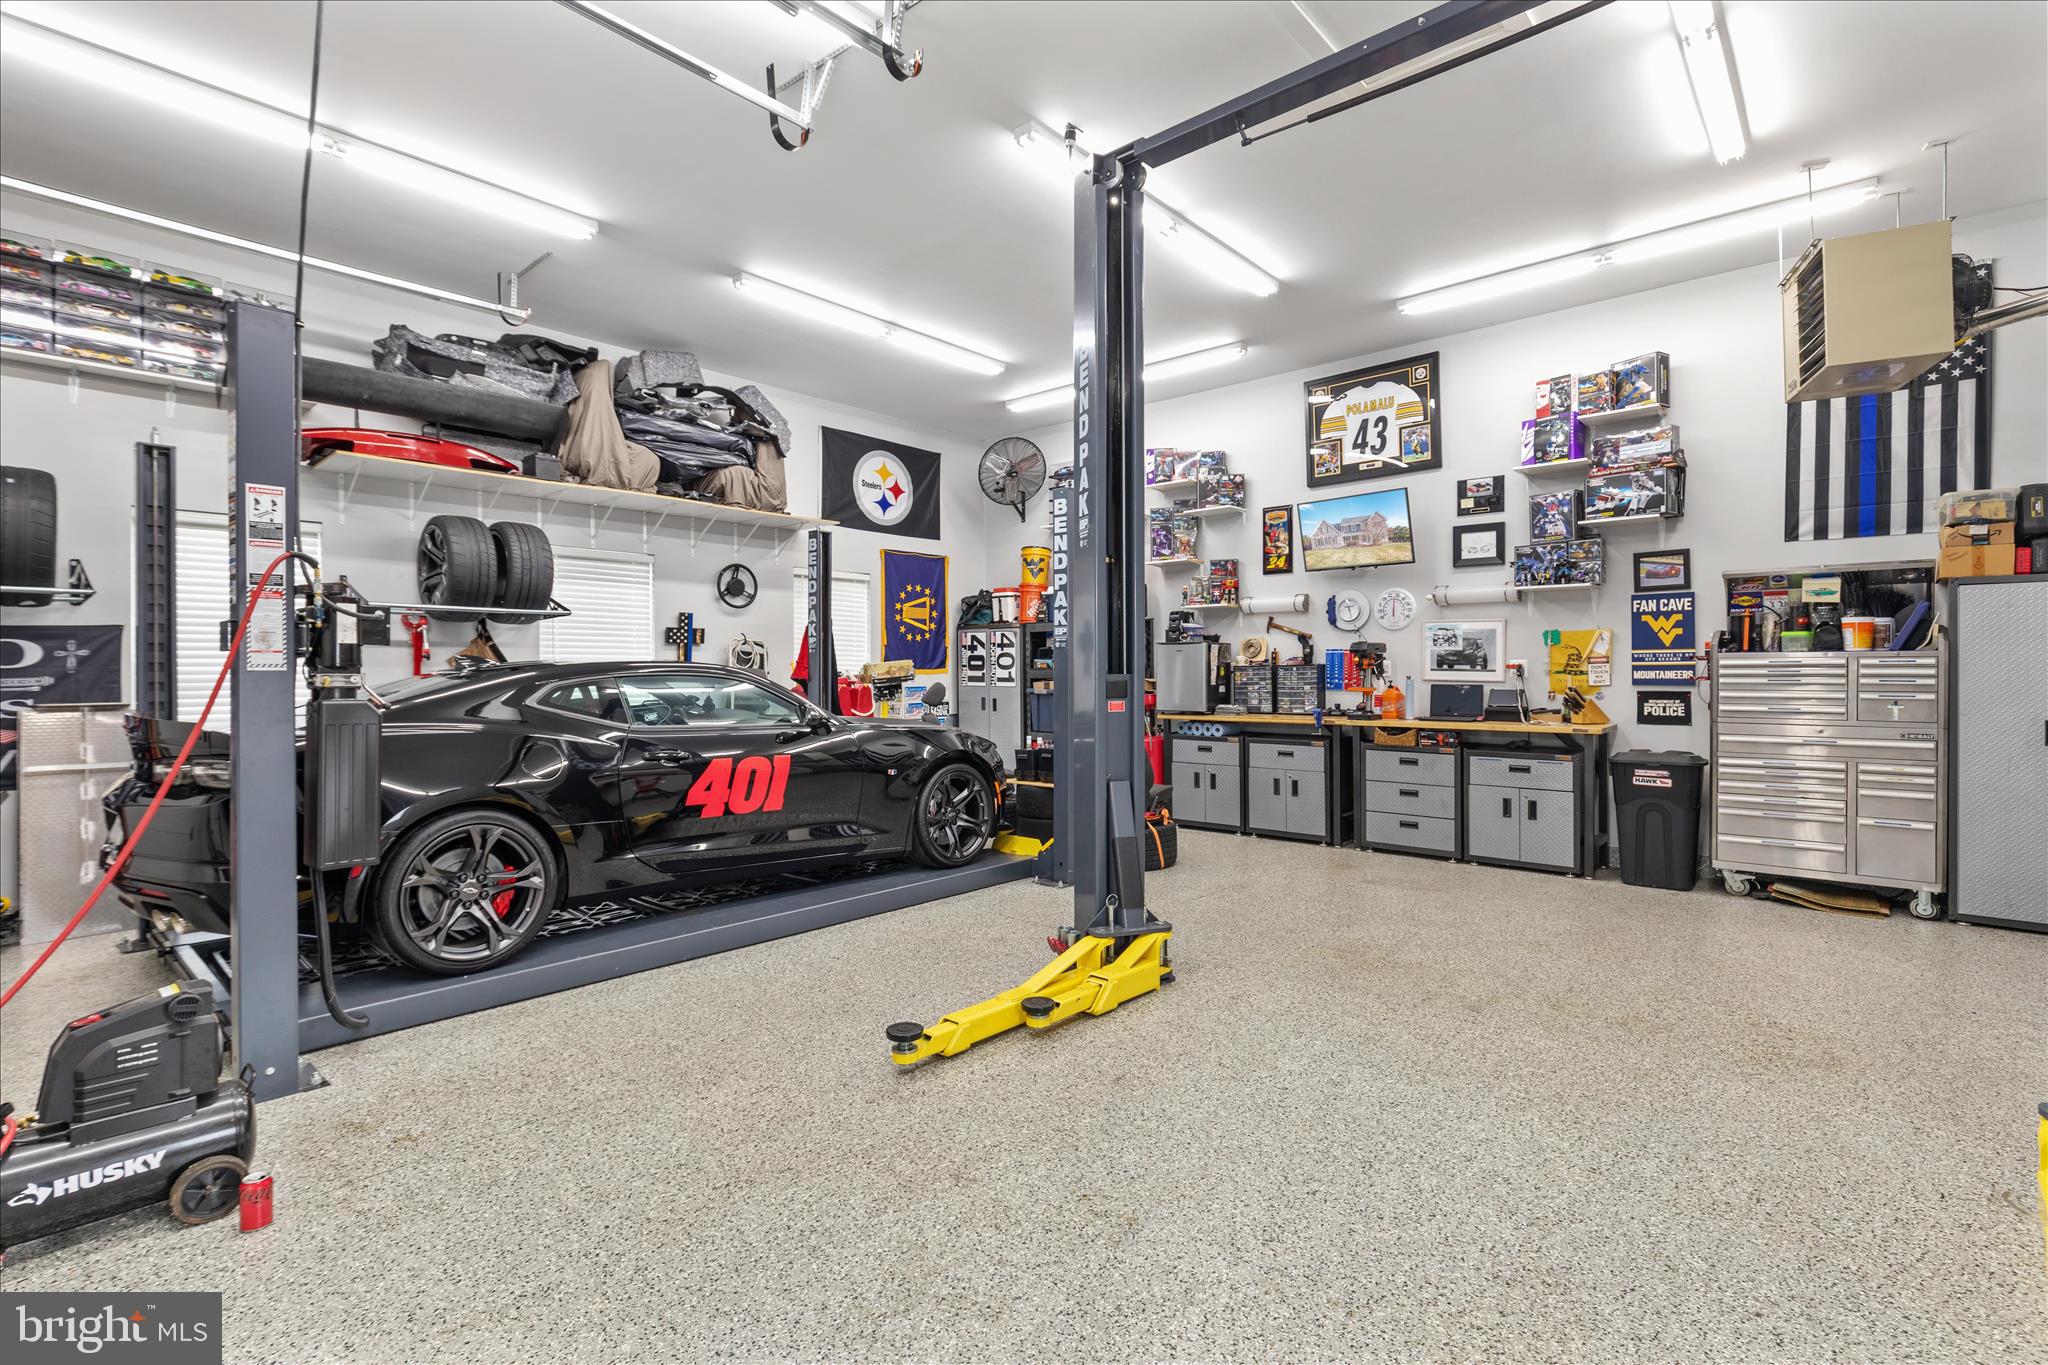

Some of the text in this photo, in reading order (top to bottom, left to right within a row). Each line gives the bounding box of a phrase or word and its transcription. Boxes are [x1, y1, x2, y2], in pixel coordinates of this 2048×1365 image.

[1346, 396, 1395, 416] POLAMALU
[1352, 415, 1388, 455] 43
[861, 479, 882, 490] Steelers
[1054, 498, 1068, 626] BENDPAK
[1267, 556, 1286, 569] 24
[808, 538, 817, 636] BENDPAK
[1633, 597, 1692, 612] FAN CAVE
[967, 634, 986, 683] 401
[996, 633, 1015, 683] 401
[1633, 670, 1694, 680] MOUNTAINEERS
[1643, 706, 1686, 717] POLICE
[685, 754, 792, 819] 401
[1634, 777, 1658, 785] HAWK
[53, 1150, 167, 1198] HUSKY
